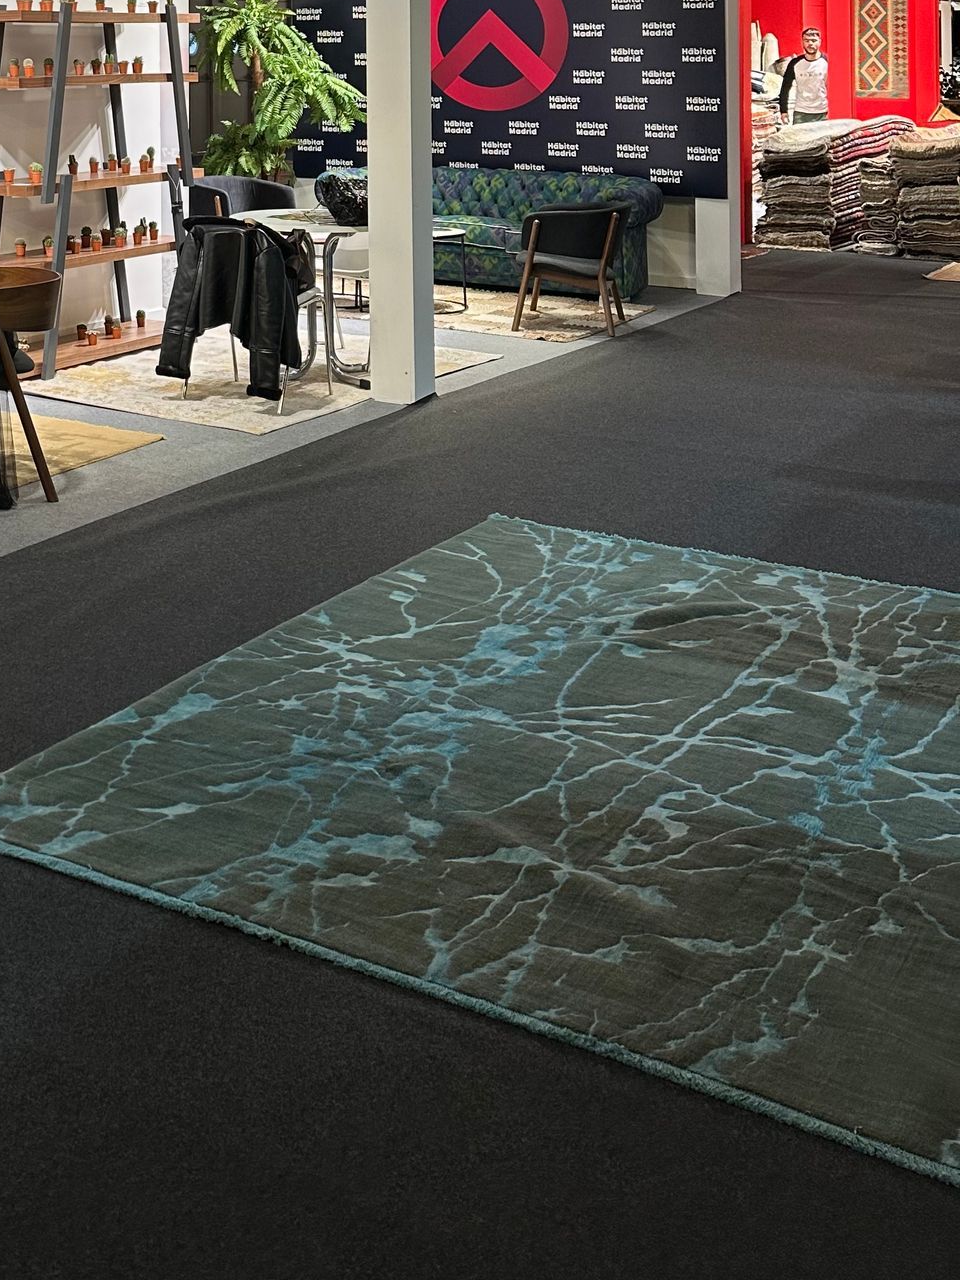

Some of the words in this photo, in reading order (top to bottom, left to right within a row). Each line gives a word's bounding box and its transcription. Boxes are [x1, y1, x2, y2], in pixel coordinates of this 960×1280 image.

[682, 54, 713, 62] Madrid
[616, 102, 645, 110] Madrid
[687, 103, 717, 111] Madrid
[509, 127, 537, 135] Madrid
[577, 128, 605, 136] Madrid
[645, 130, 675, 138] Madrid
[482, 147, 509, 155] Madrid
[548, 149, 576, 157] Madrid
[617, 150, 646, 159] Madrid
[687, 153, 718, 161] Madrid
[650, 175, 680, 183] Madrid
